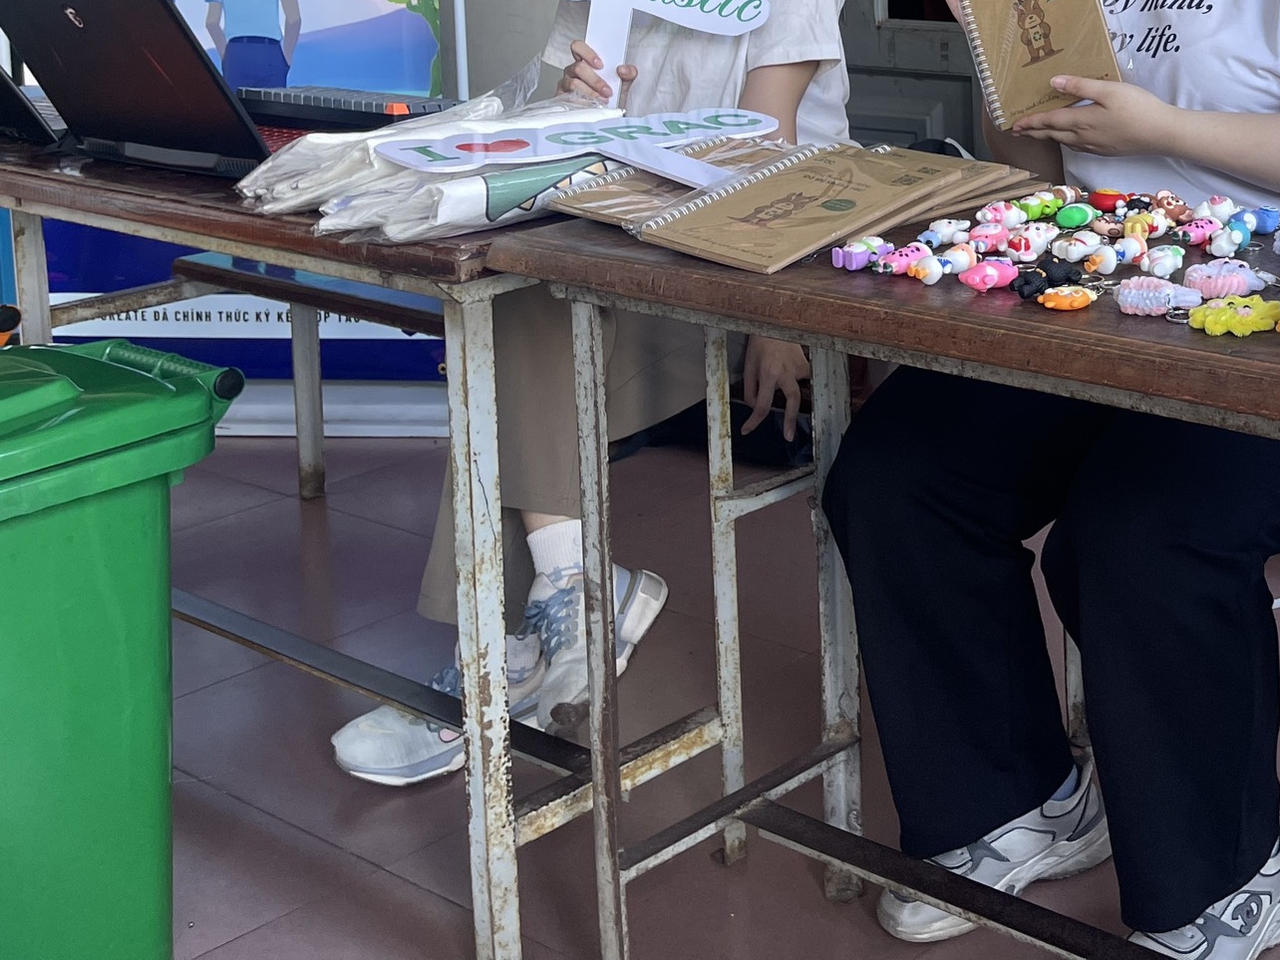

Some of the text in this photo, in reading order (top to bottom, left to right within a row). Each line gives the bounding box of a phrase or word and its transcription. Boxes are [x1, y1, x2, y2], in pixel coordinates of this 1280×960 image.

[1136, 24, 1180, 58] life.
[400, 113, 762, 163] I GRAC
[175, 308, 212, 322] CHÍNH
[218, 308, 249, 322] THỨC
